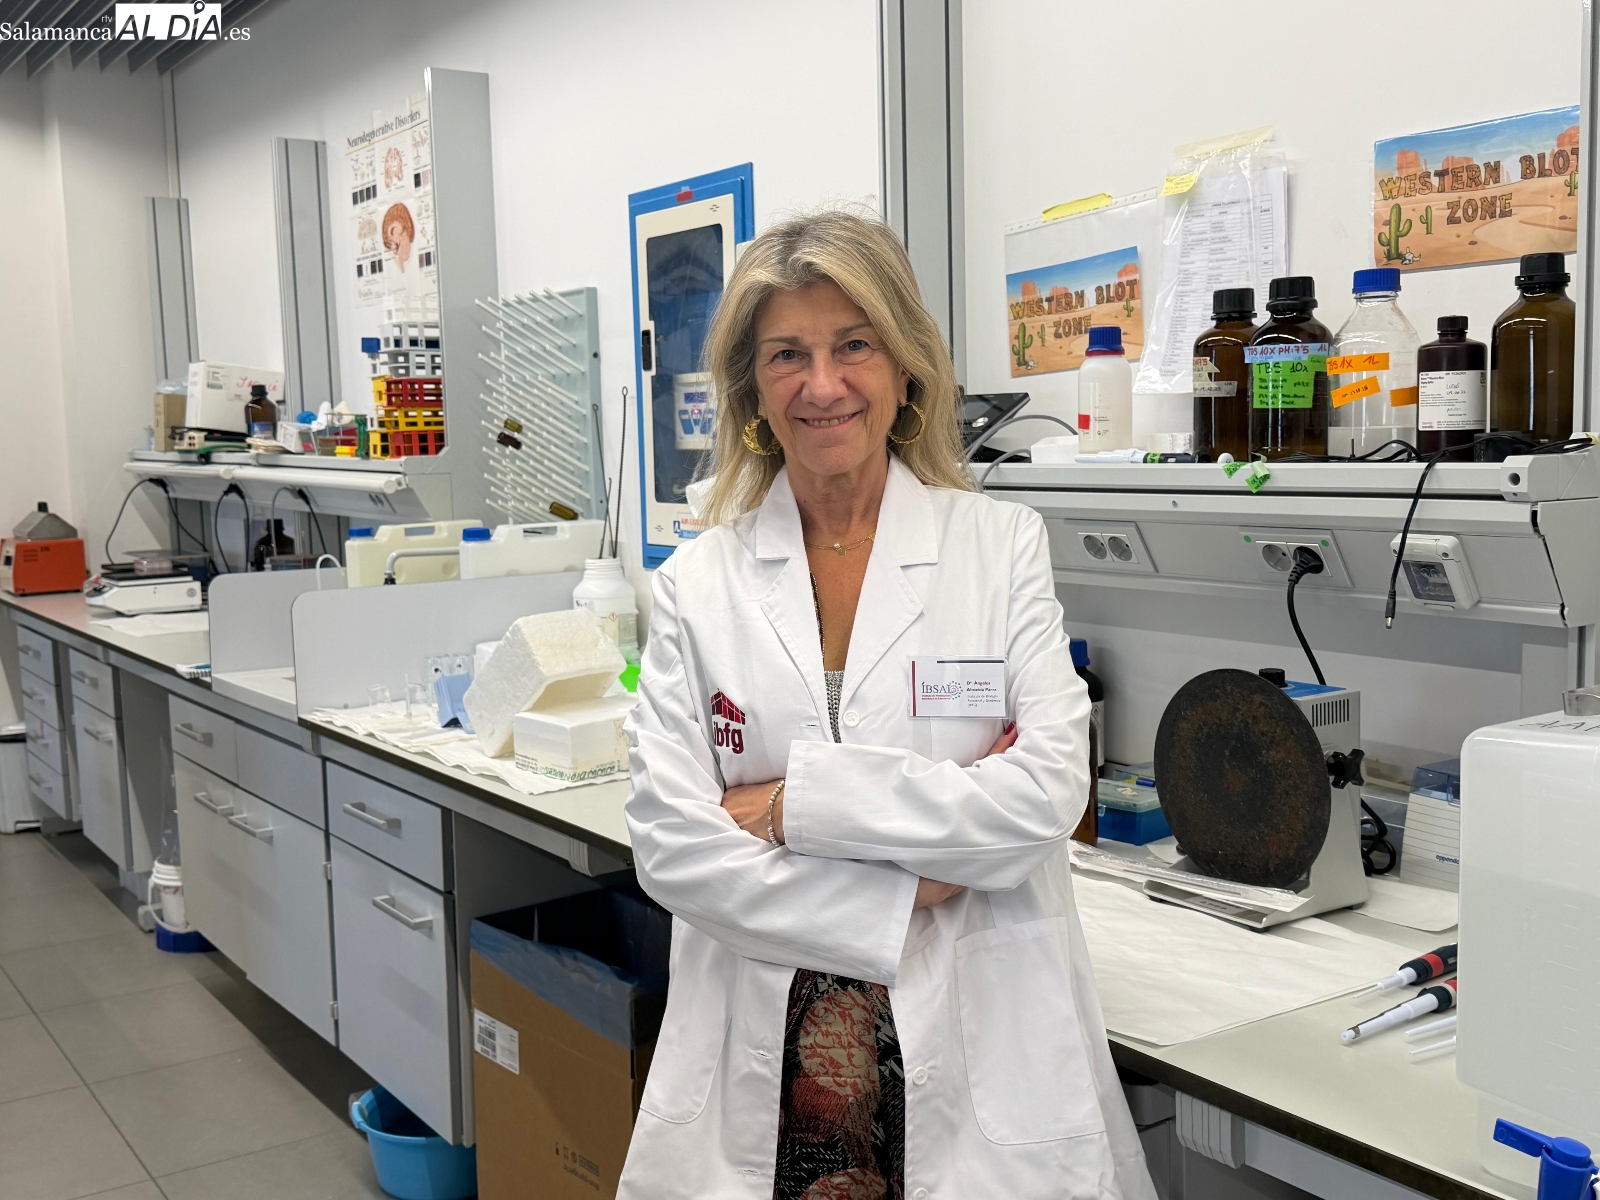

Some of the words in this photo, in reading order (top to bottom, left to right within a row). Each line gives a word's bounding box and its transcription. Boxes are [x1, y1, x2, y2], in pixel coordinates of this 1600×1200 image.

[395, 110, 421, 129] Disorders
[1378, 160, 1501, 200] WESTERN
[1519, 147, 1579, 180] BLOT
[1447, 193, 1513, 225] ZONE
[1009, 290, 1085, 320] WESTERN
[1095, 280, 1138, 306] BLOT
[1053, 315, 1092, 339] ZONE
[1256, 362, 1282, 374] TBS
